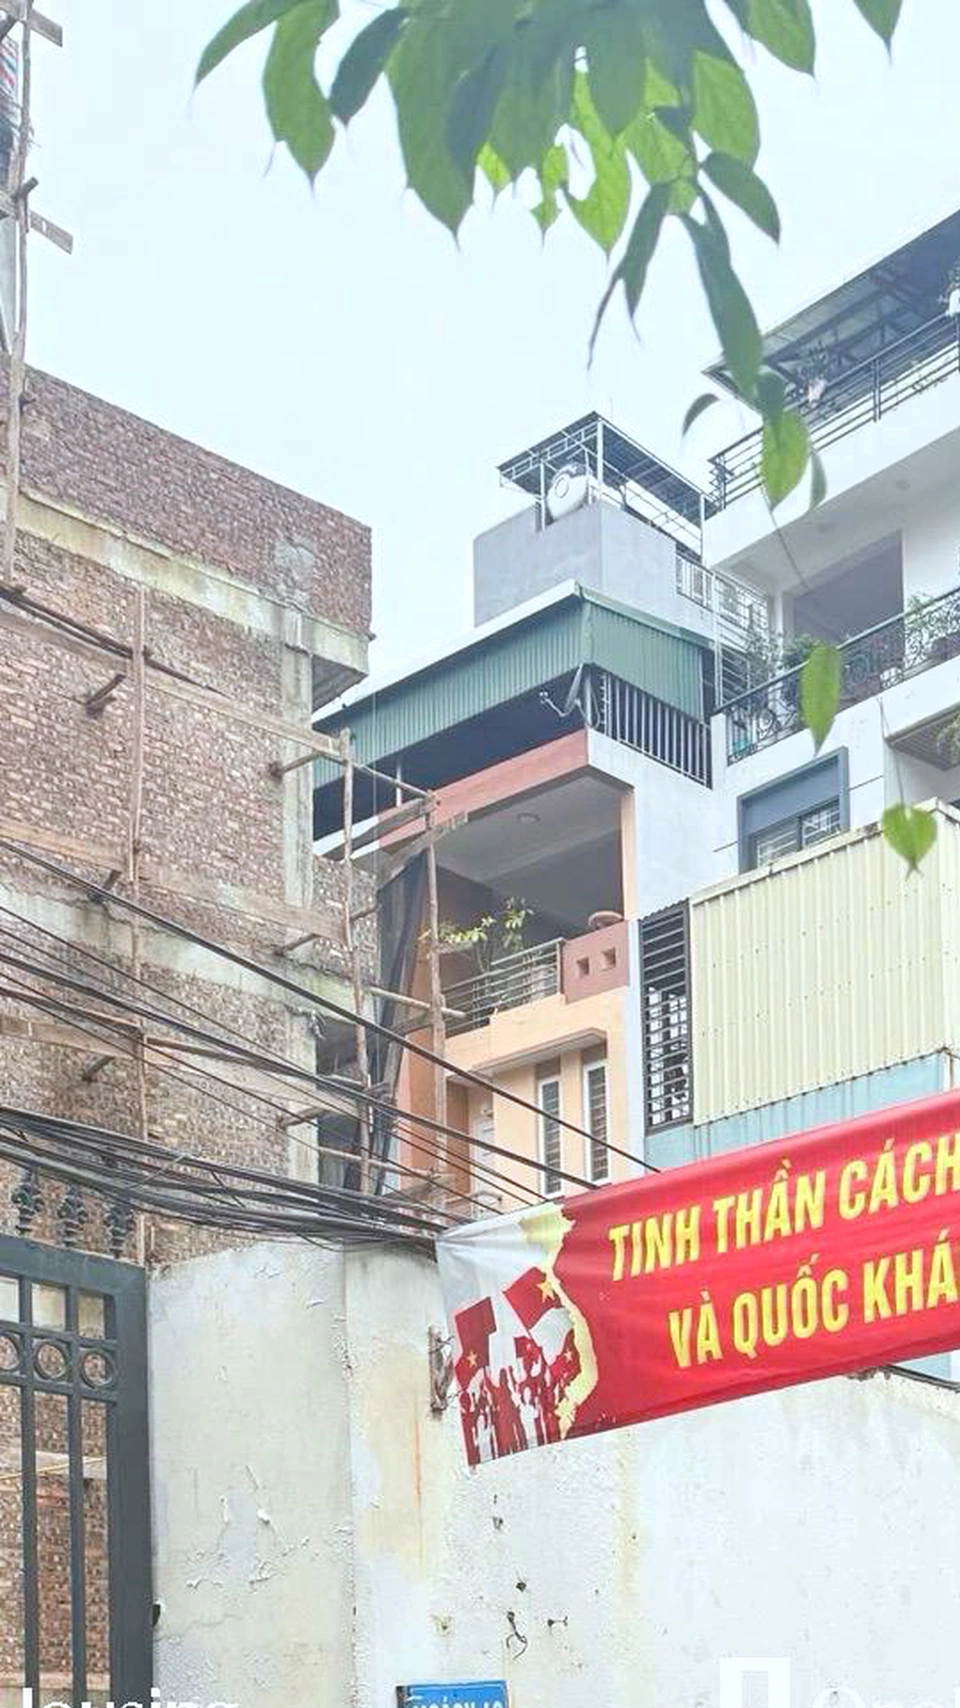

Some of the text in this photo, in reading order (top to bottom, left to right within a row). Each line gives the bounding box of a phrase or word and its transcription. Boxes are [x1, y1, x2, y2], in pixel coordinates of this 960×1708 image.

[608, 1205, 701, 1282] TINH
[713, 1158, 826, 1253] THẦN
[668, 1290, 723, 1368] VÀ
[732, 1253, 850, 1359] QUỐC
